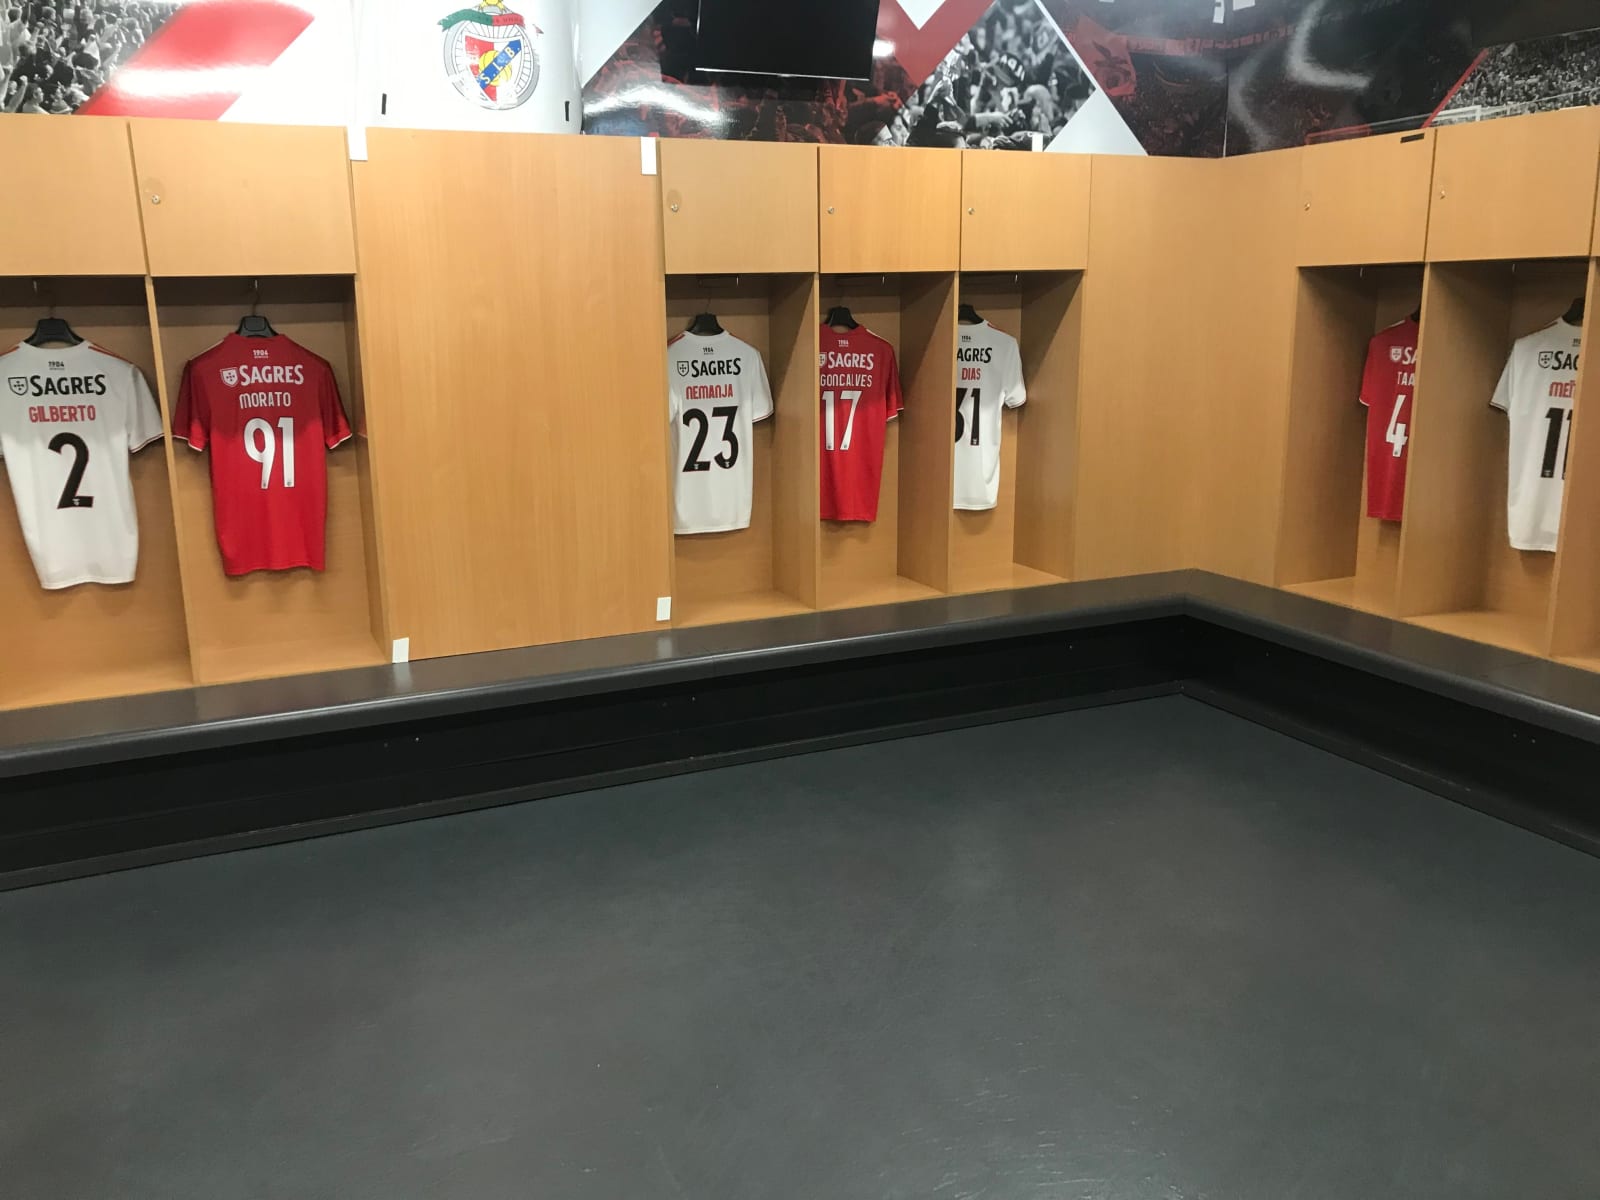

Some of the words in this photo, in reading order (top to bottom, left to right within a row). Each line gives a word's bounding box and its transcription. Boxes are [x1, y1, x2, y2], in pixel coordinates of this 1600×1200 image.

[691, 358, 741, 378] SAGRES
[828, 352, 874, 371] SAGRES
[239, 364, 304, 387] SAGRES
[962, 367, 981, 380] DIAS
[30, 374, 106, 397] SAGRES
[685, 384, 733, 400] NEMANJA
[239, 391, 291, 409] MORATO
[29, 405, 96, 423] GILBERTO
[822, 390, 862, 450] 17
[1385, 394, 1408, 458] 4
[683, 405, 738, 472] 23
[243, 417, 295, 489] 91
[47, 432, 94, 509] 2
